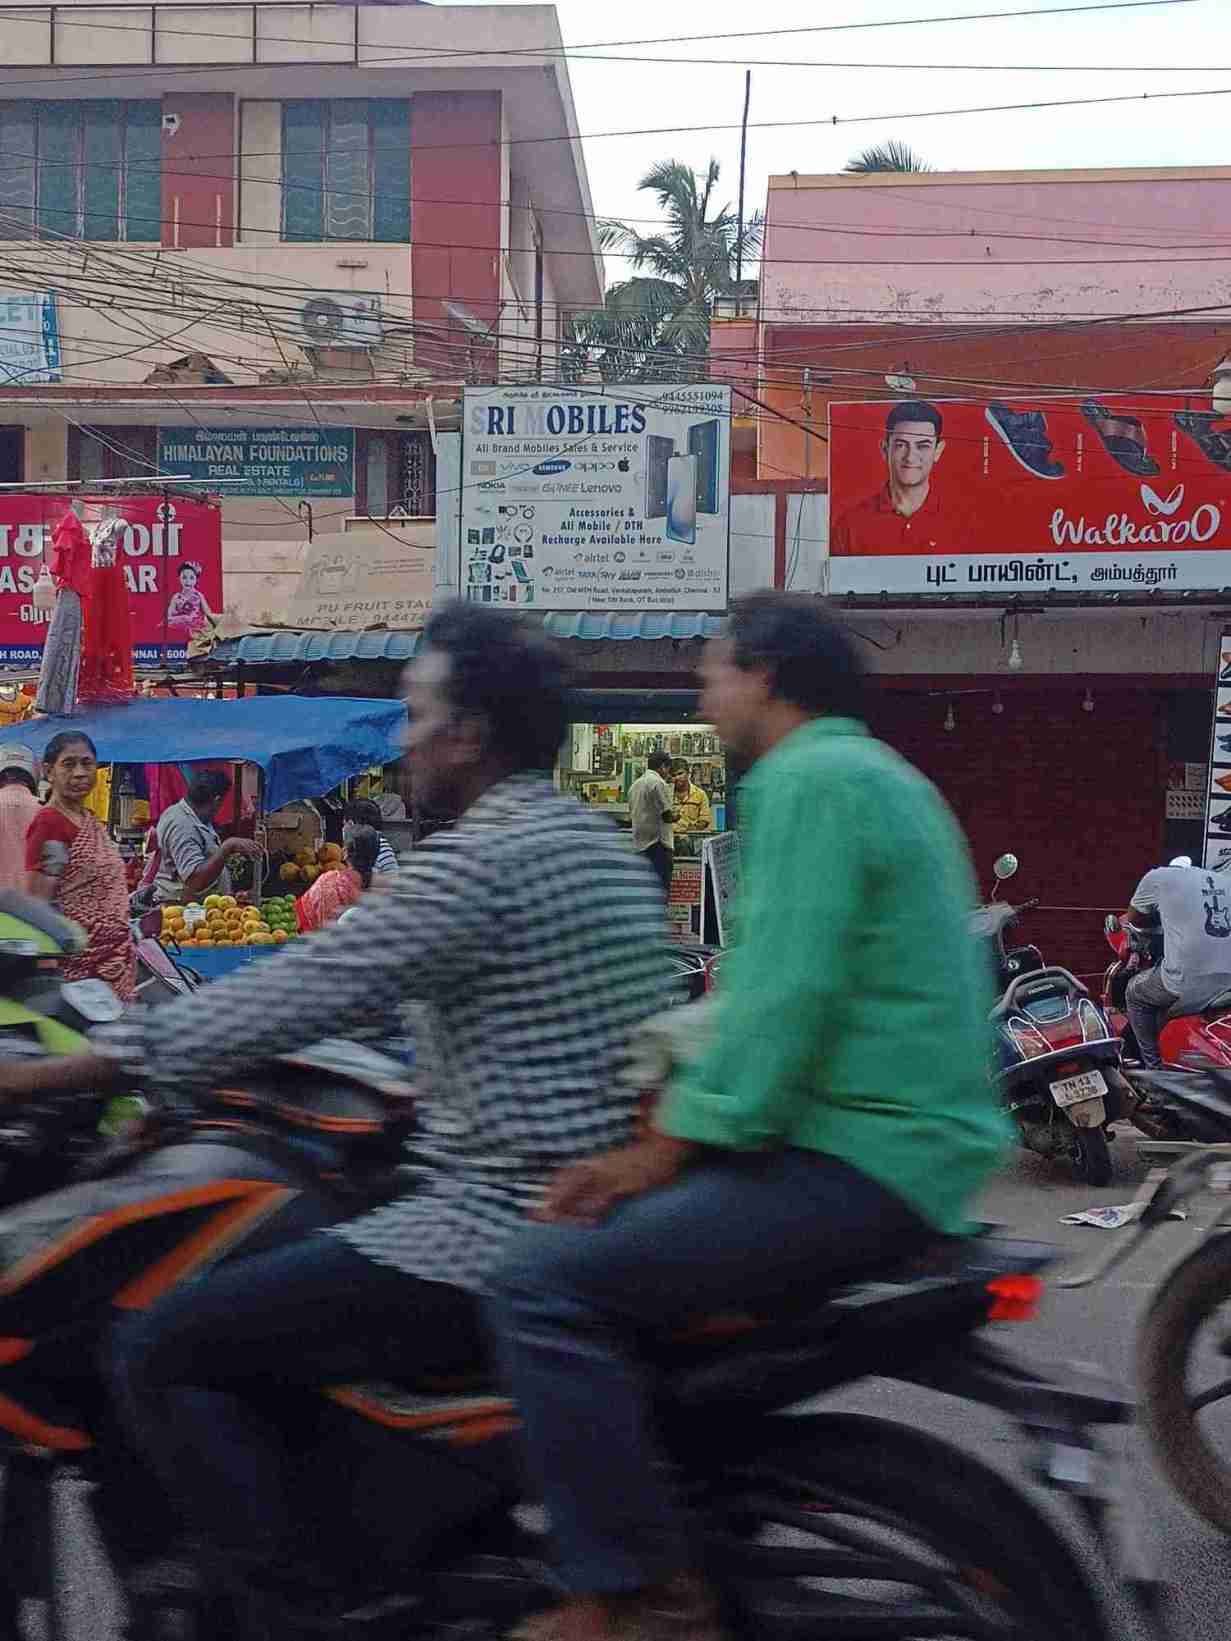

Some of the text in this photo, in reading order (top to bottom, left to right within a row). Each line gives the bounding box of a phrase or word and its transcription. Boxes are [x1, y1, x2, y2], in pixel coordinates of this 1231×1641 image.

[471, 405, 646, 435] SRI MOBILES
[476, 441, 638, 453] All Brand Mobiles Sales & Service
[164, 445, 348, 462] HIMALAYAN FOUNDATIONS
[208, 465, 291, 476] REAL ESTATE
[580, 482, 623, 493] Lenovo
[569, 507, 635, 517] Accessories &
[560, 521, 574, 530] All
[579, 521, 610, 530] Mobile
[624, 521, 643, 530] DTH
[542, 534, 662, 546] Recharge Available Here
[584, 551, 609, 563] airtel
[926, 562, 957, 587] புட்
[1090, 562, 1178, 585] அம்பத்தூர்
[344, 601, 391, 612] FRUIT
[10, 650, 42, 661] ROAD,
[1063, 1078, 1077, 1091] TN
